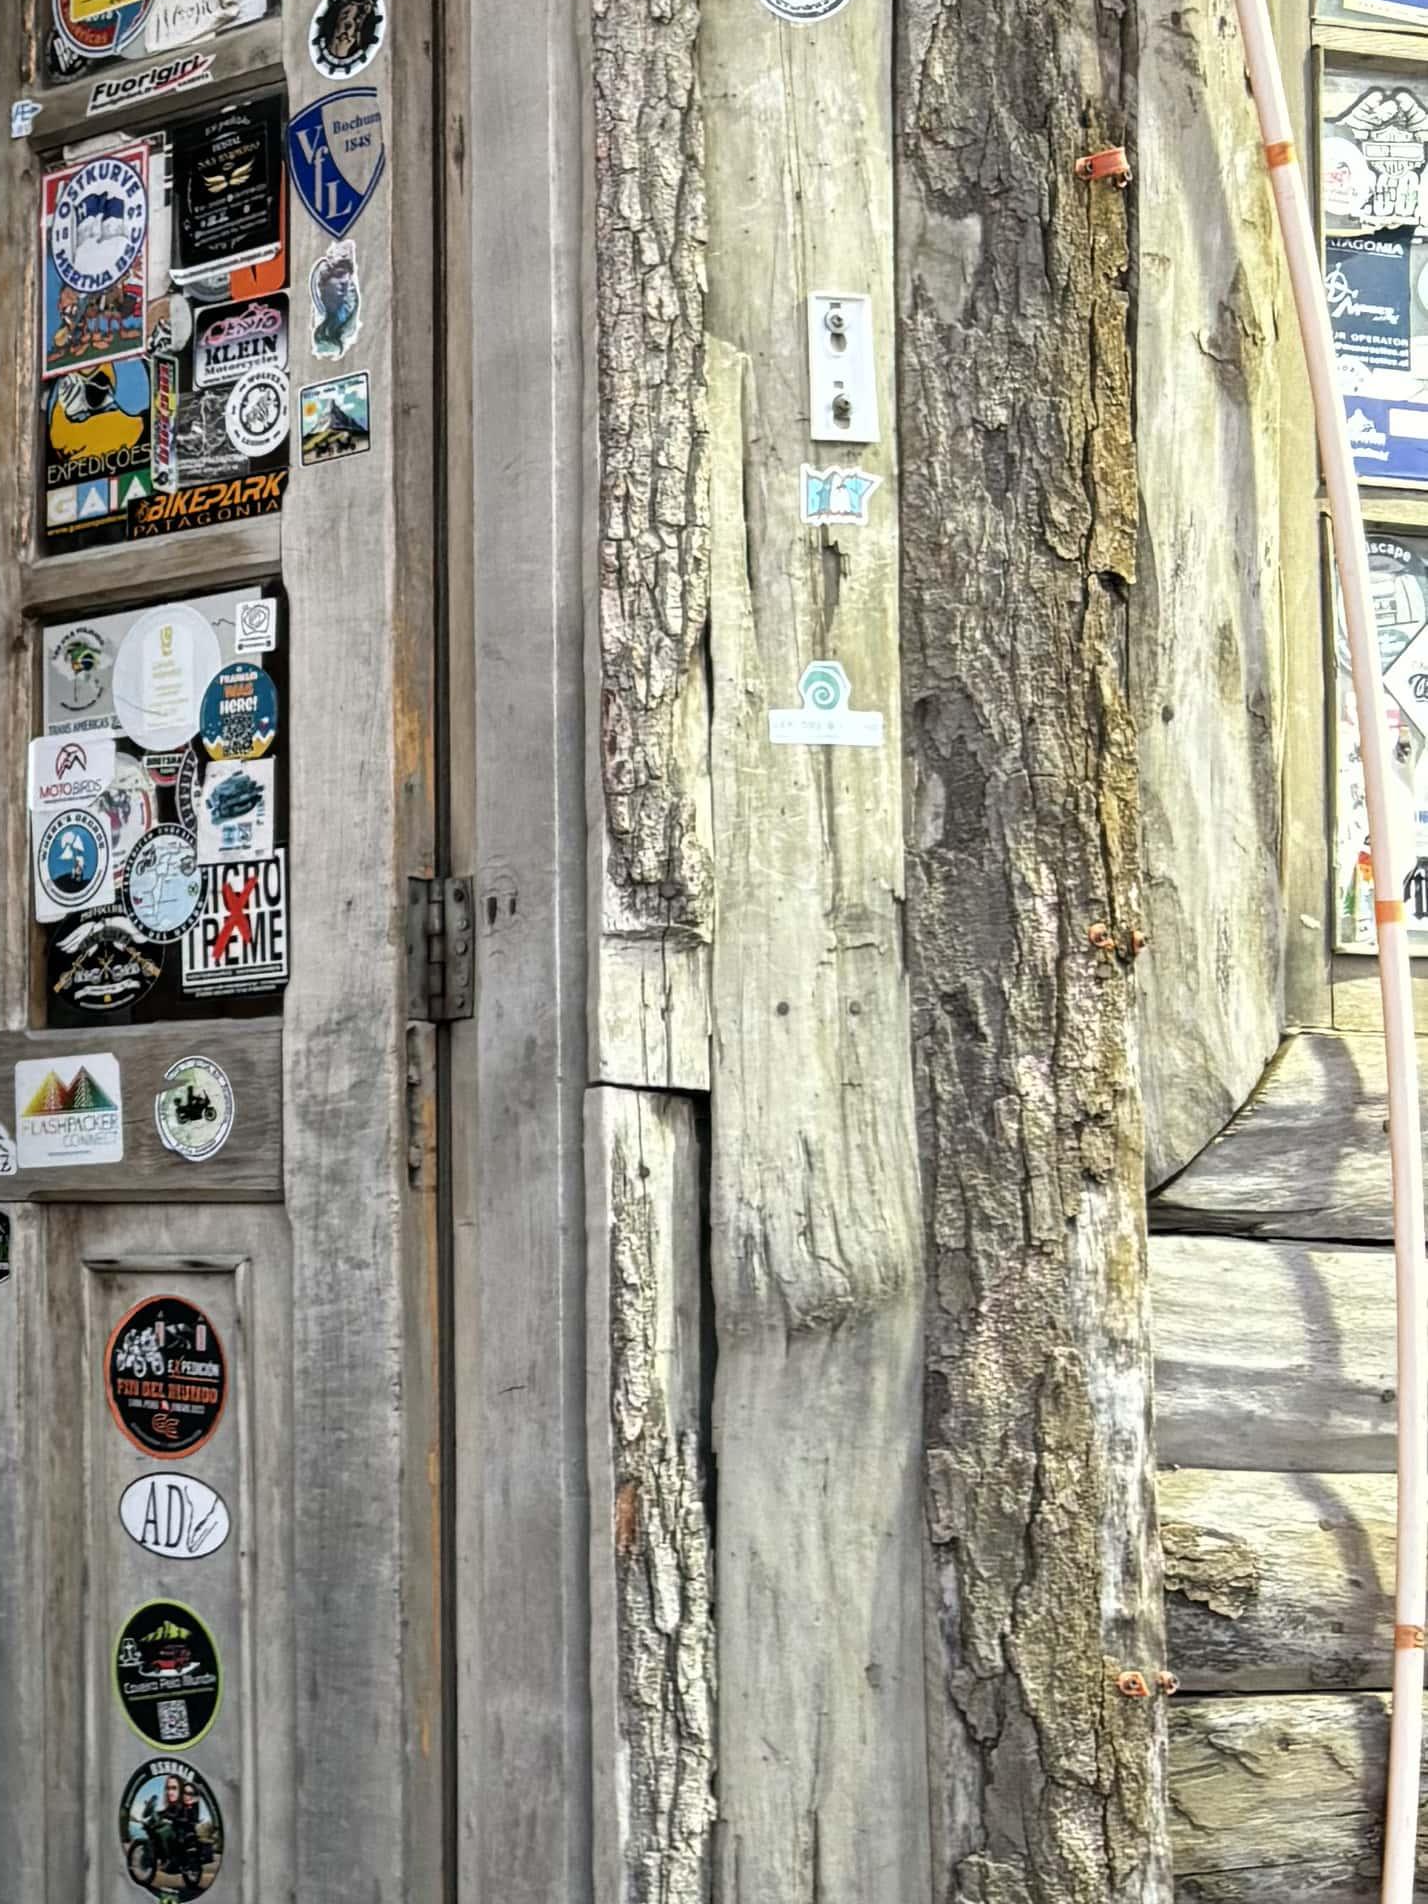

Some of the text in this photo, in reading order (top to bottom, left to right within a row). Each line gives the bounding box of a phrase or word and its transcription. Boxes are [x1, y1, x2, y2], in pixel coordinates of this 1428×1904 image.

[331, 104, 383, 135] Bochum
[343, 131, 372, 153] 1848
[58, 159, 141, 218] OSTKURVE
[56, 226, 142, 287] HERTHA BSC
[204, 335, 279, 365] KLEIN
[46, 444, 151, 484] EXPEDIÇÕES
[145, 471, 285, 521] BIKEPARK
[132, 499, 280, 539] PATAGONIA
[21, 1114, 119, 1136] FLASHPACKER
[62, 1132, 119, 1149] CONNECT
